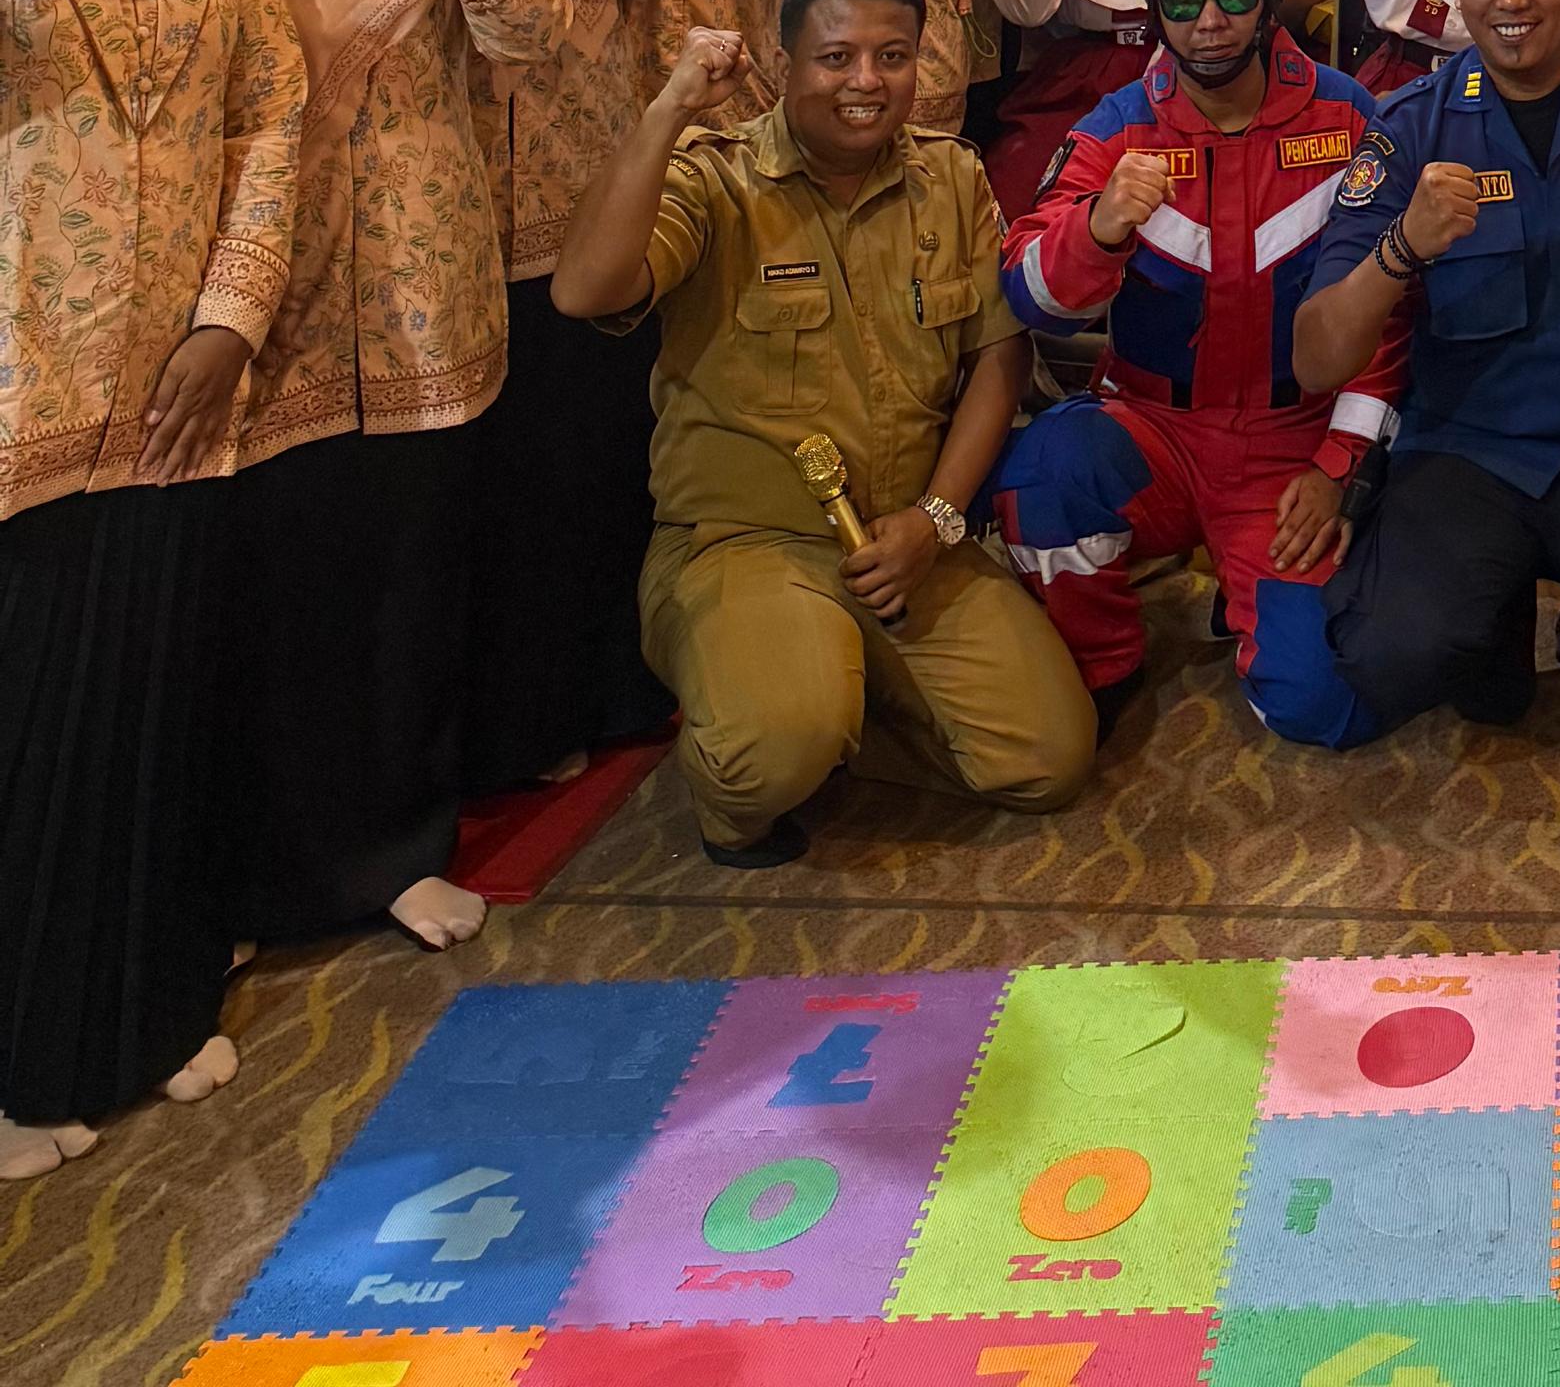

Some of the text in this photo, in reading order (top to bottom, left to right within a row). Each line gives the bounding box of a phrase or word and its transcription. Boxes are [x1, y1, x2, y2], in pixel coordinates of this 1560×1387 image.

[1284, 134, 1348, 163] PENYELAMAT
[374, 1166, 526, 1262] 4
[675, 1264, 794, 1292] Zero
[1007, 1253, 1123, 1283] Zero
[346, 1273, 464, 1305] Four
